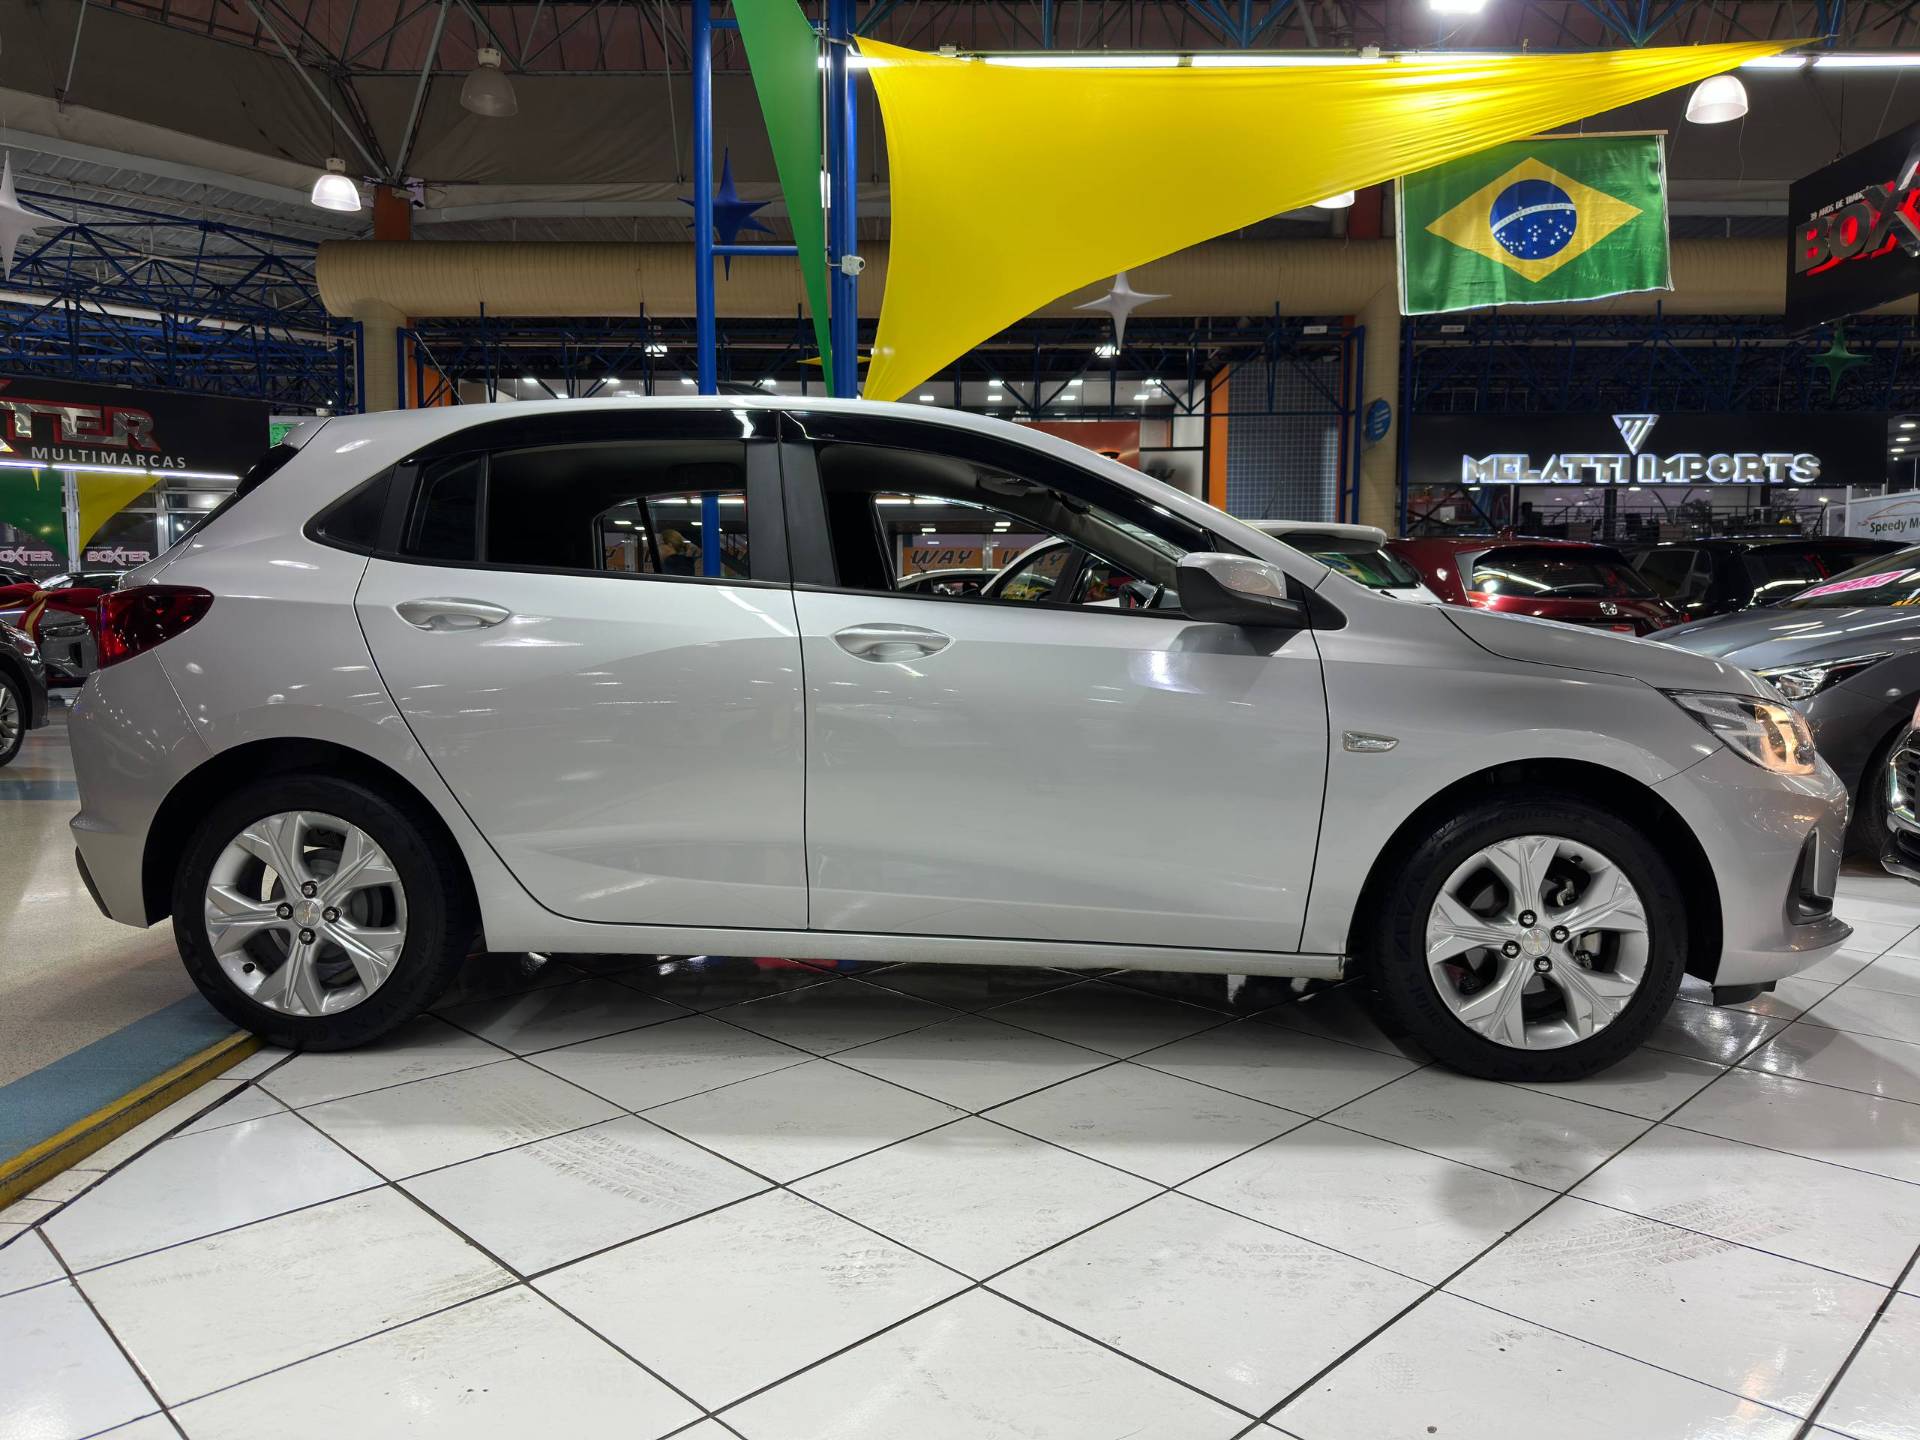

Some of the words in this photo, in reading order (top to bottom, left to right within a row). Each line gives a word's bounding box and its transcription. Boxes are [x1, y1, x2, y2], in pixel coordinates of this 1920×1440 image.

[31, 446, 187, 469] MULTIMARCAS
[1462, 453, 1631, 484] MELATTI
[1637, 453, 1821, 483] IMPORTS
[1869, 519, 1907, 535] Speedy
[1909, 517, 1920, 529] M
[0, 546, 54, 566] OXTER
[87, 546, 151, 566] BOXTER
[911, 550, 973, 564] WAY
